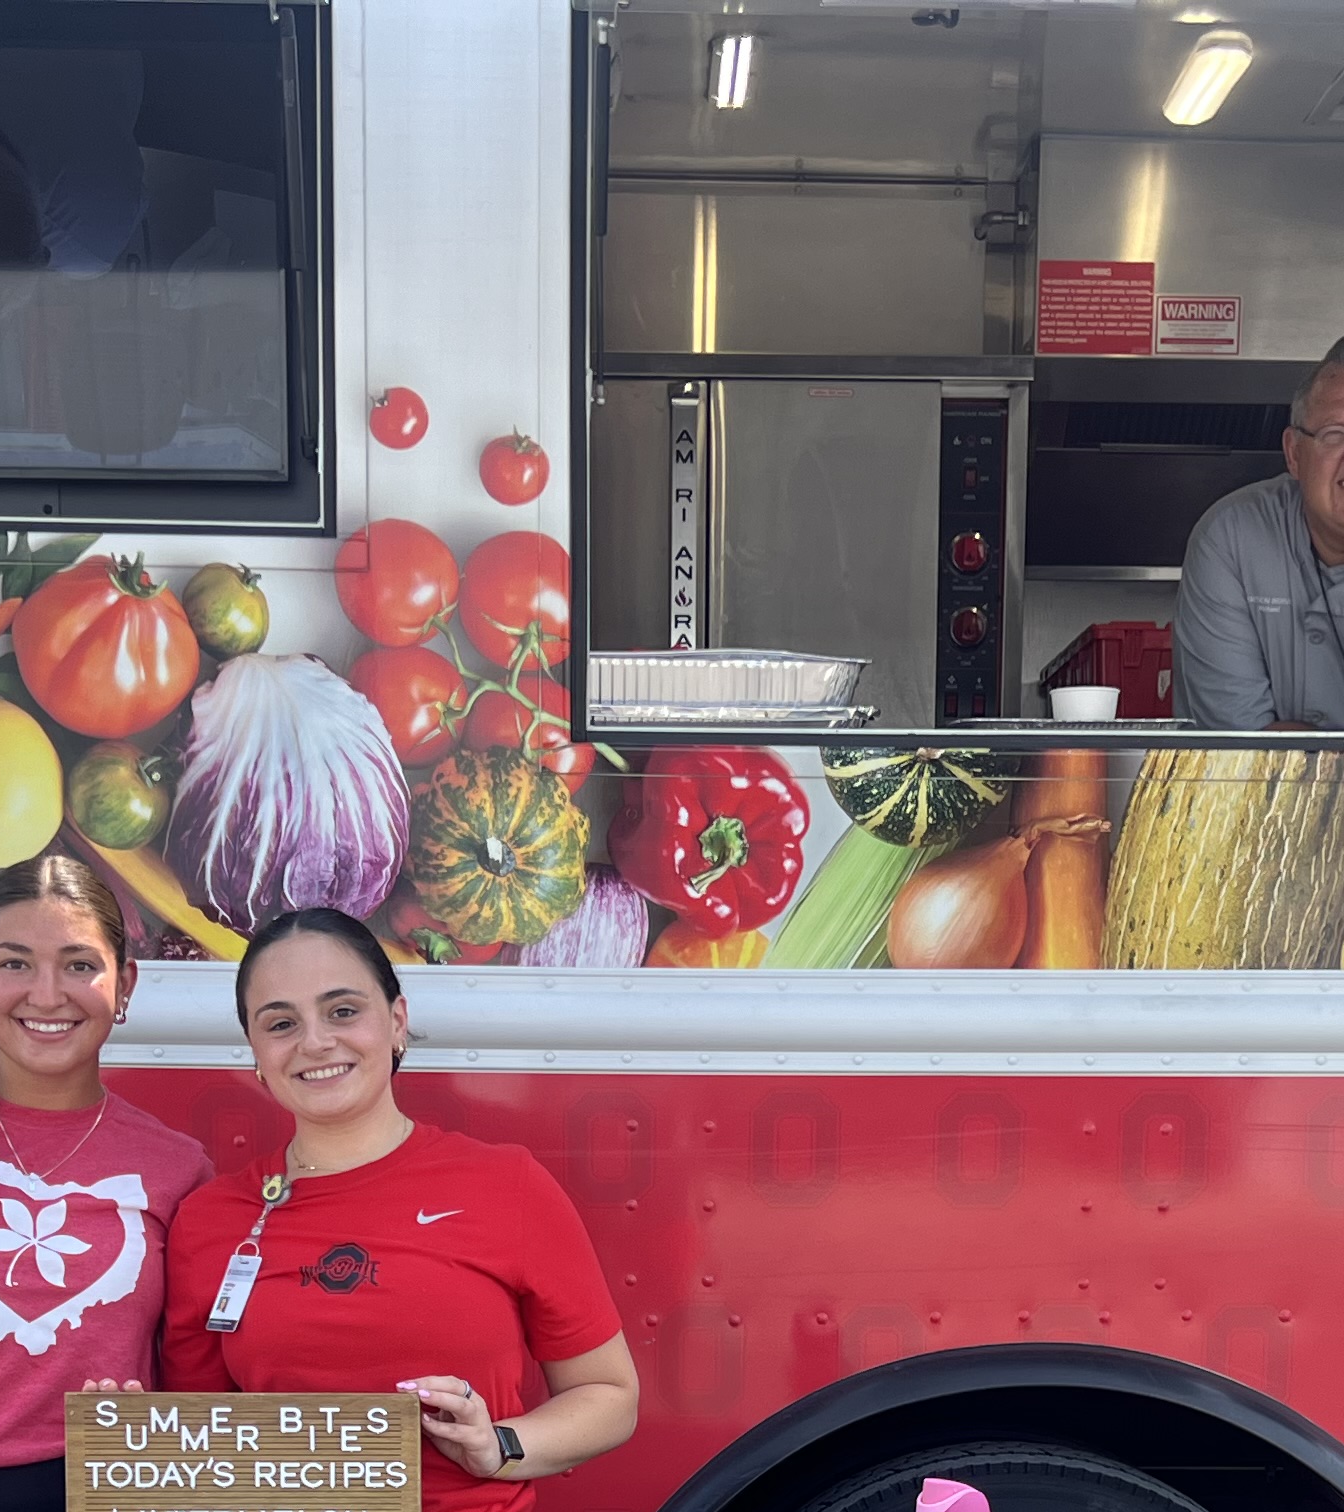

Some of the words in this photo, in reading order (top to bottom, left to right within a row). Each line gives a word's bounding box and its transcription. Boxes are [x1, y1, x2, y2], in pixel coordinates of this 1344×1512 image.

[1163, 303, 1235, 320] WARNING
[94, 1400, 260, 1453] SUMMER
[278, 1406, 390, 1454] BITES
[84, 1456, 236, 1490] TODAY'S
[254, 1461, 409, 1490] RECIPES
